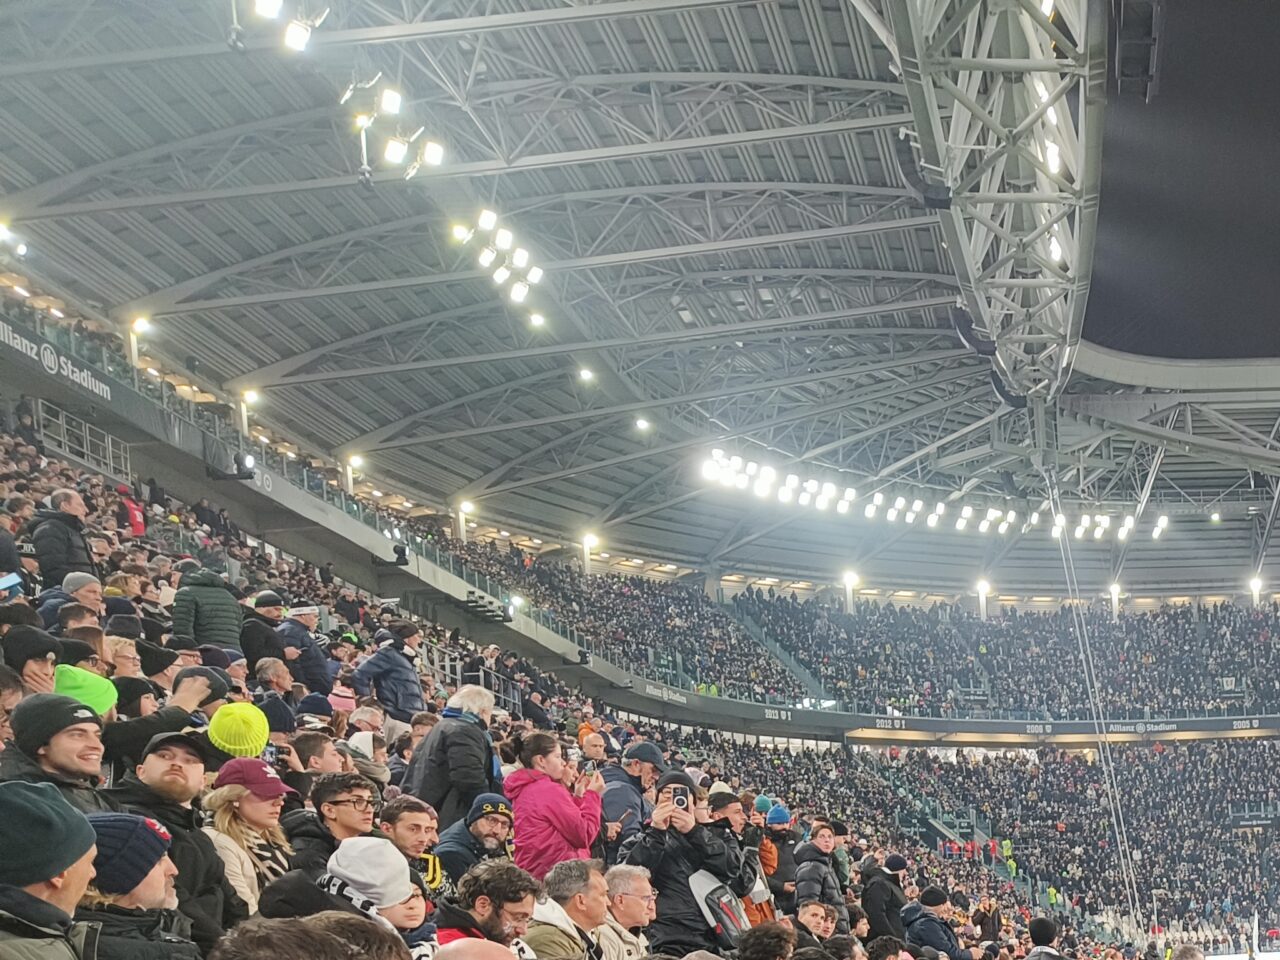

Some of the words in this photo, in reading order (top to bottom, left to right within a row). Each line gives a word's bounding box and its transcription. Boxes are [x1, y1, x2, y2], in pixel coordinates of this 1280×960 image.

[0, 321, 39, 361] llianz
[60, 355, 112, 401] Stadium
[764, 708, 779, 720] 2013
[875, 718, 893, 729] 2012
[1109, 723, 1135, 732] Allianz
[1146, 722, 1177, 731] Stadium
[1232, 719, 1251, 729] 2005
